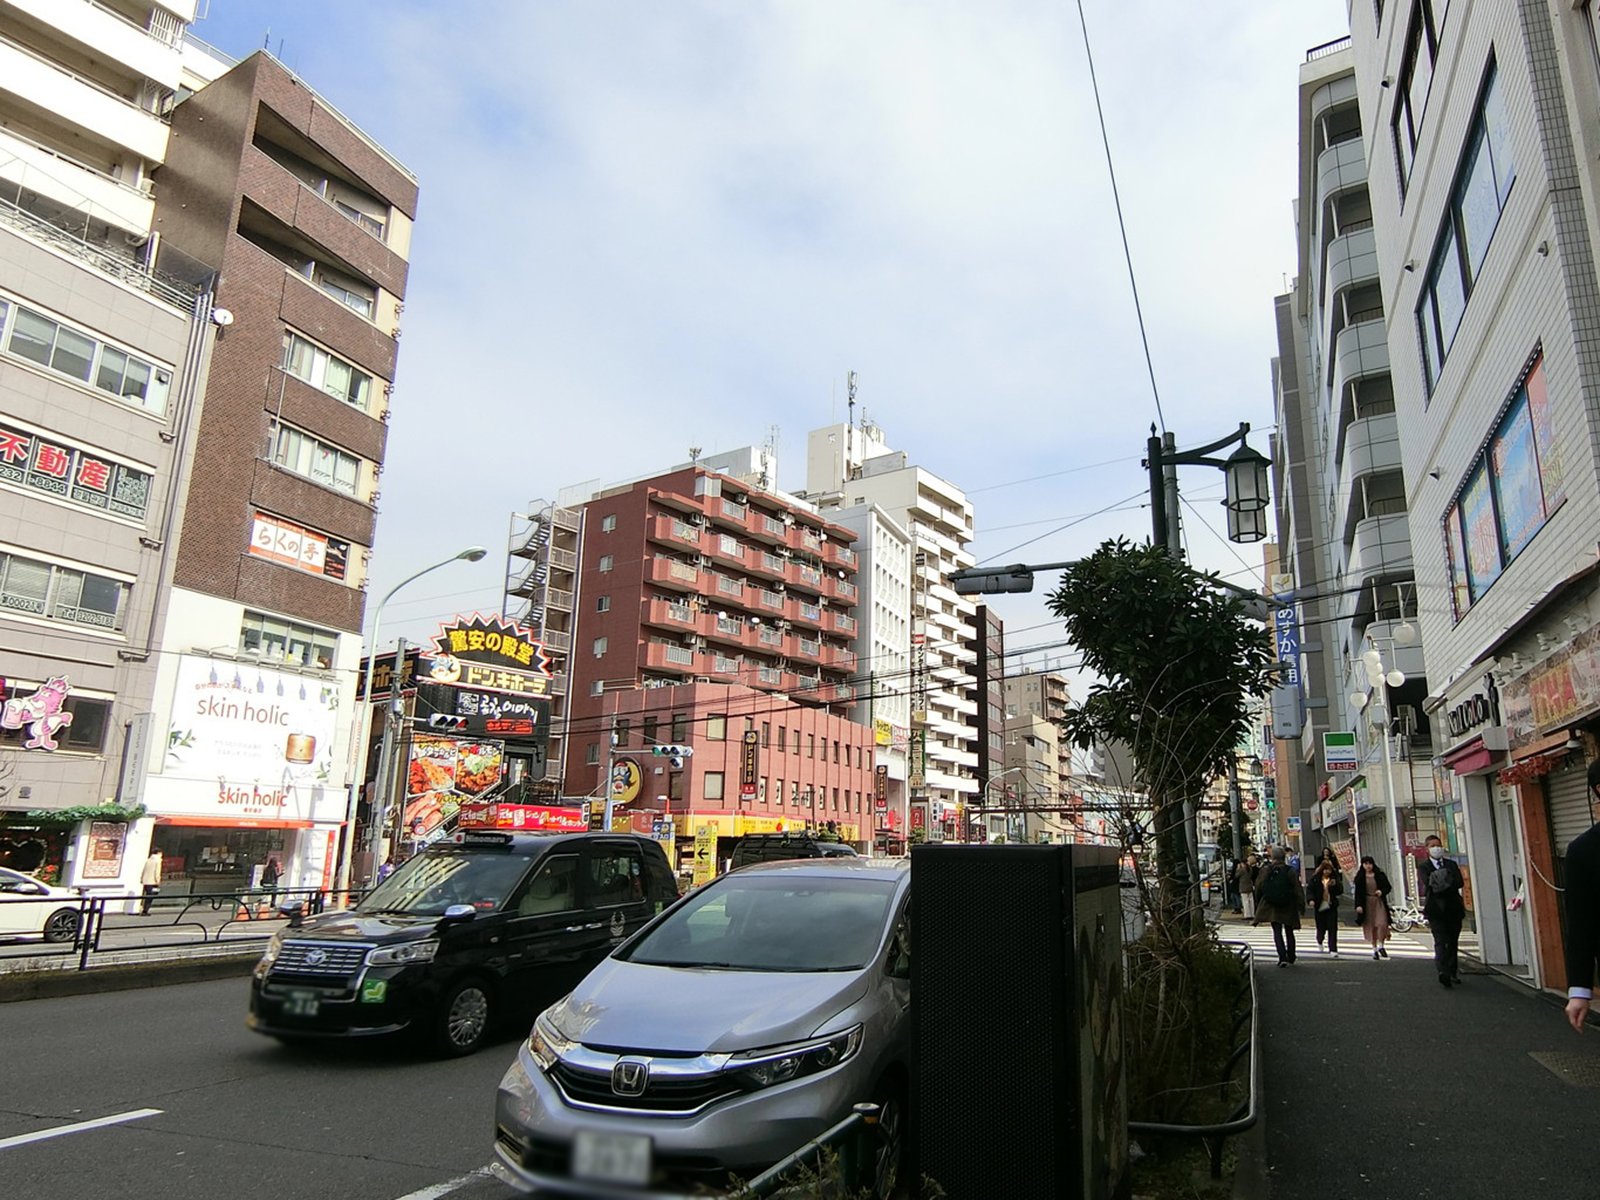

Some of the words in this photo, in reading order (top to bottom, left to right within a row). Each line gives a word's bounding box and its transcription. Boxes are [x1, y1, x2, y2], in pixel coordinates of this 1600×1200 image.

[0, 430, 111, 493] 不動産
[450, 629, 535, 666] 驚安の殿堂
[197, 695, 239, 719] skin
[243, 701, 290, 727] holic
[218, 787, 249, 804] skin
[253, 788, 288, 807] holic
